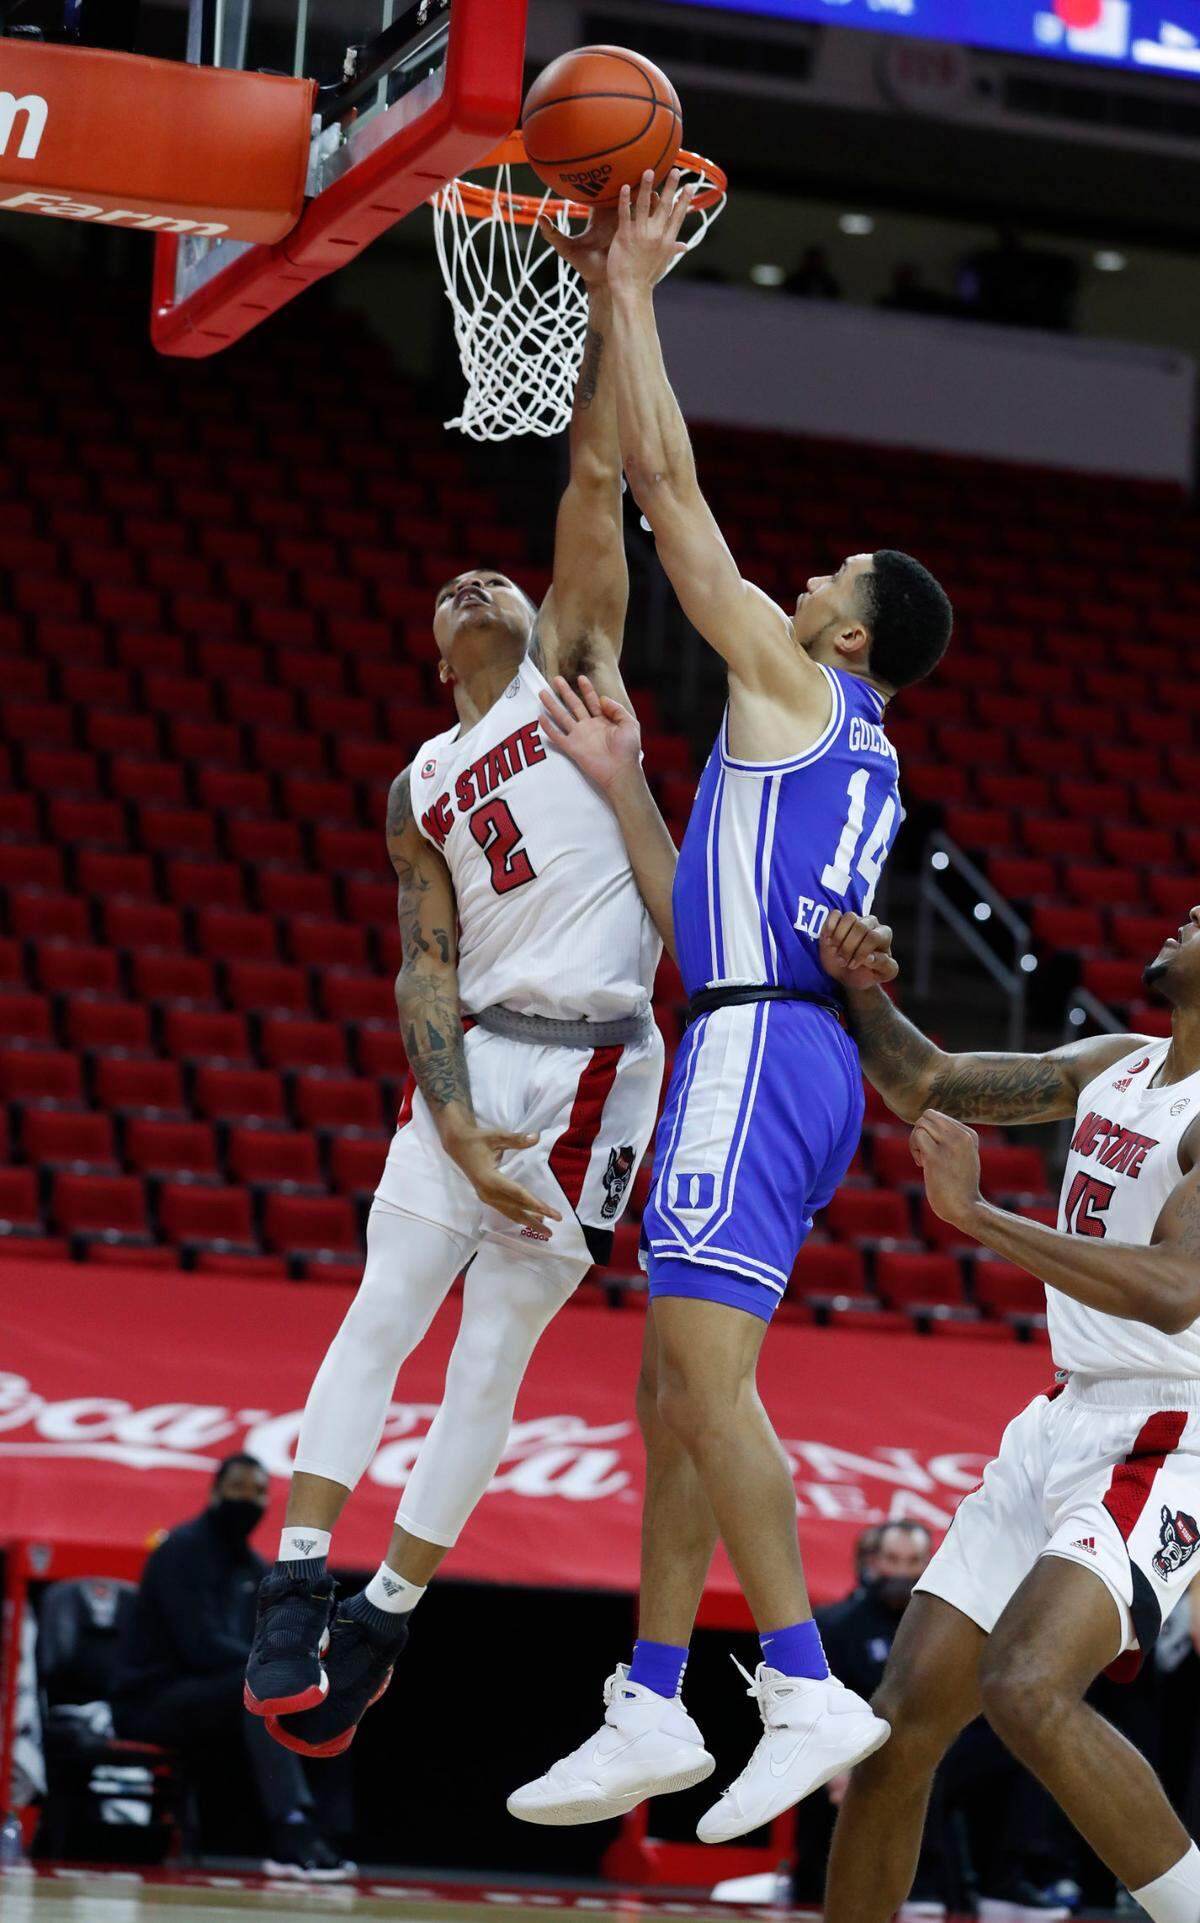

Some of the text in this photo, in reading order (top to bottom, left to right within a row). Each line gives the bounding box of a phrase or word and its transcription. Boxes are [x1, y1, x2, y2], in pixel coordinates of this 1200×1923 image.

[559, 163, 612, 184] adidas
[0, 192, 229, 236] Farm
[422, 719, 547, 850] NC STATE
[469, 797, 537, 895] 2
[821, 768, 896, 916] 14
[673, 1173, 715, 1209] D
[1065, 1170, 1117, 1238] 15
